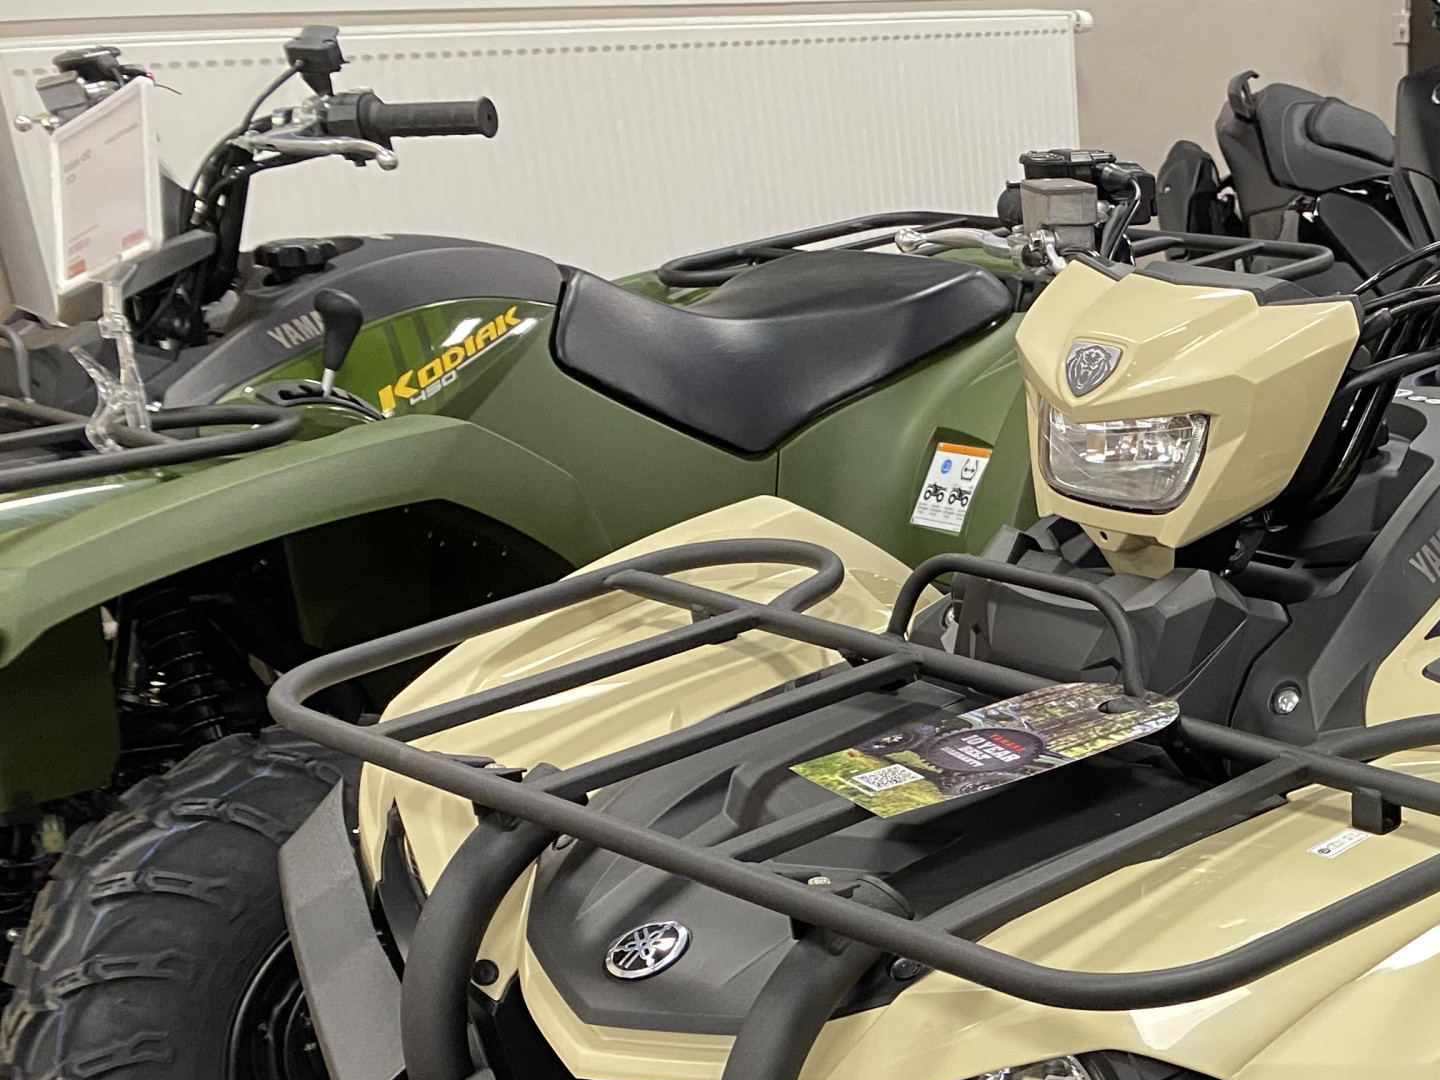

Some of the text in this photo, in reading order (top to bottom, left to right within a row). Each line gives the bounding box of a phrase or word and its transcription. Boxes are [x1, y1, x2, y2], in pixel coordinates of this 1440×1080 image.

[378, 306, 522, 413] KODIAK
[409, 369, 459, 406] 450
[957, 745, 993, 760] BELT
[960, 734, 1021, 763] 10 YEAR
